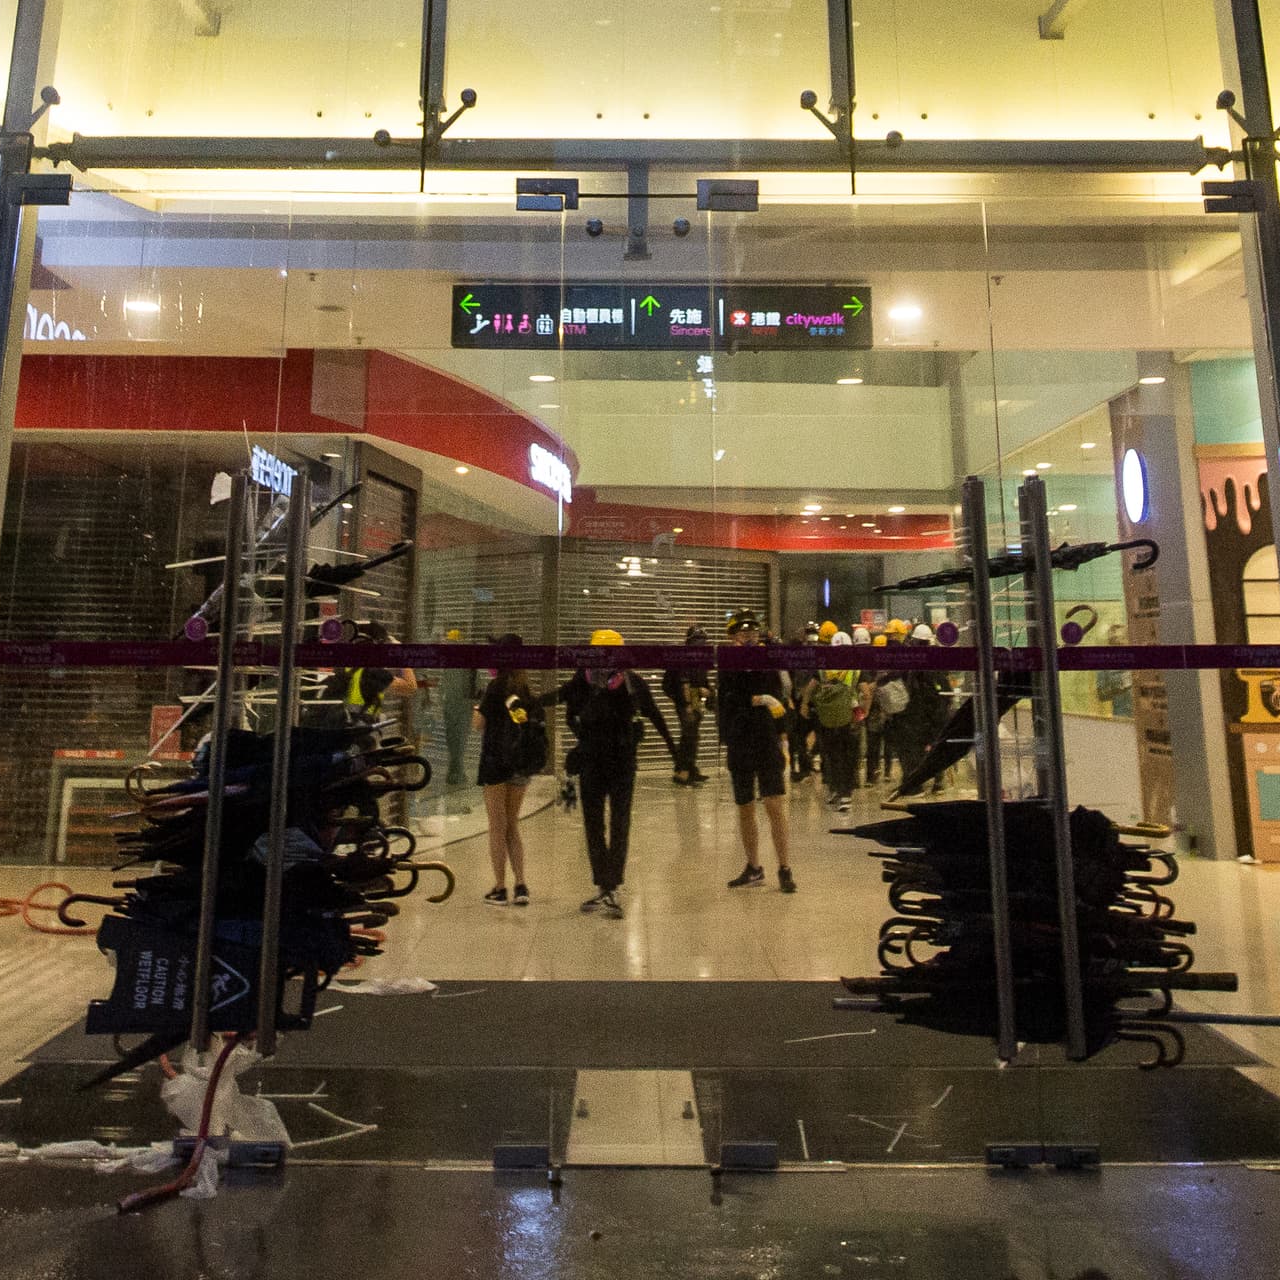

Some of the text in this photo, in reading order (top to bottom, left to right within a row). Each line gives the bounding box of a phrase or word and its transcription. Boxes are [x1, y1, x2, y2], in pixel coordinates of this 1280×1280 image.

[669, 308, 702, 325] 先施
[785, 312, 845, 329] citywalk
[151, 957, 169, 1005] CAUTION
